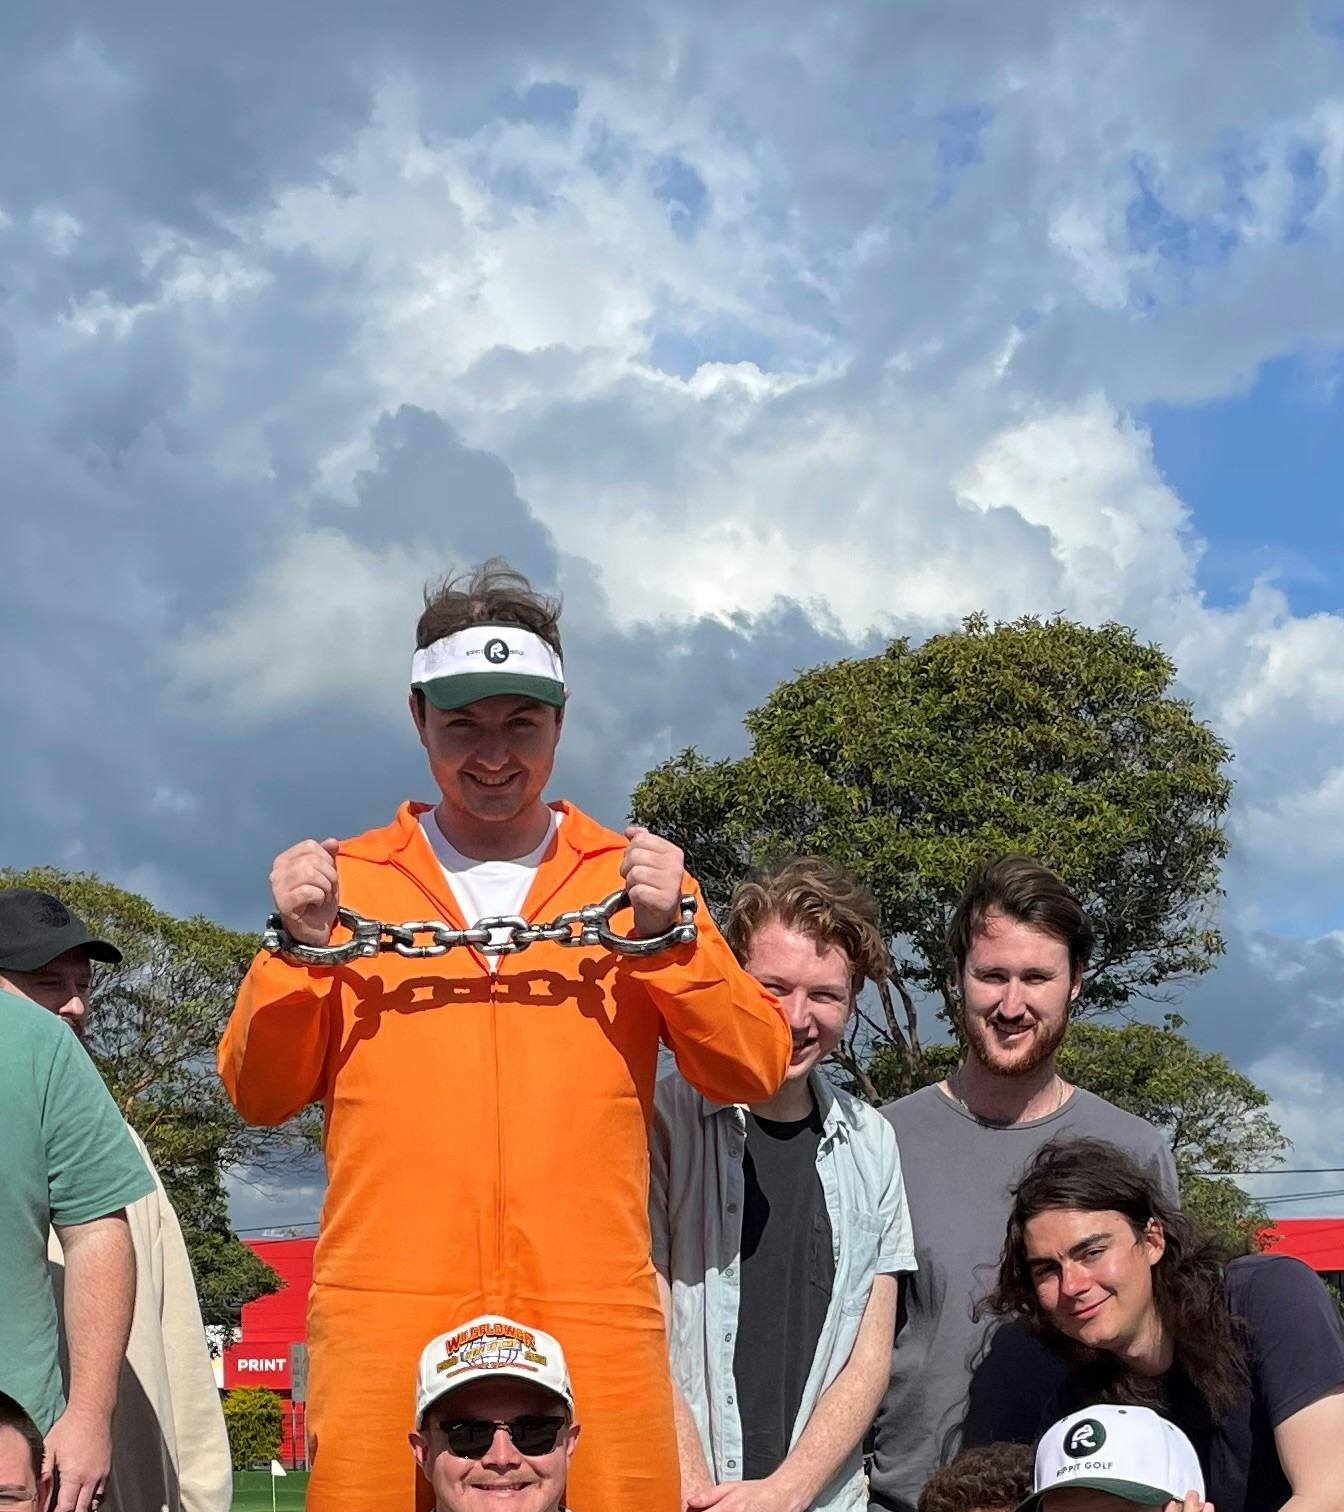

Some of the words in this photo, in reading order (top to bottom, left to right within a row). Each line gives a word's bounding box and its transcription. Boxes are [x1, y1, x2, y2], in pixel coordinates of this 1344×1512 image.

[446, 1323, 536, 1356] WILDFLOWER
[237, 1358, 287, 1372] PRINT
[1084, 1461, 1113, 1470] GOLF
